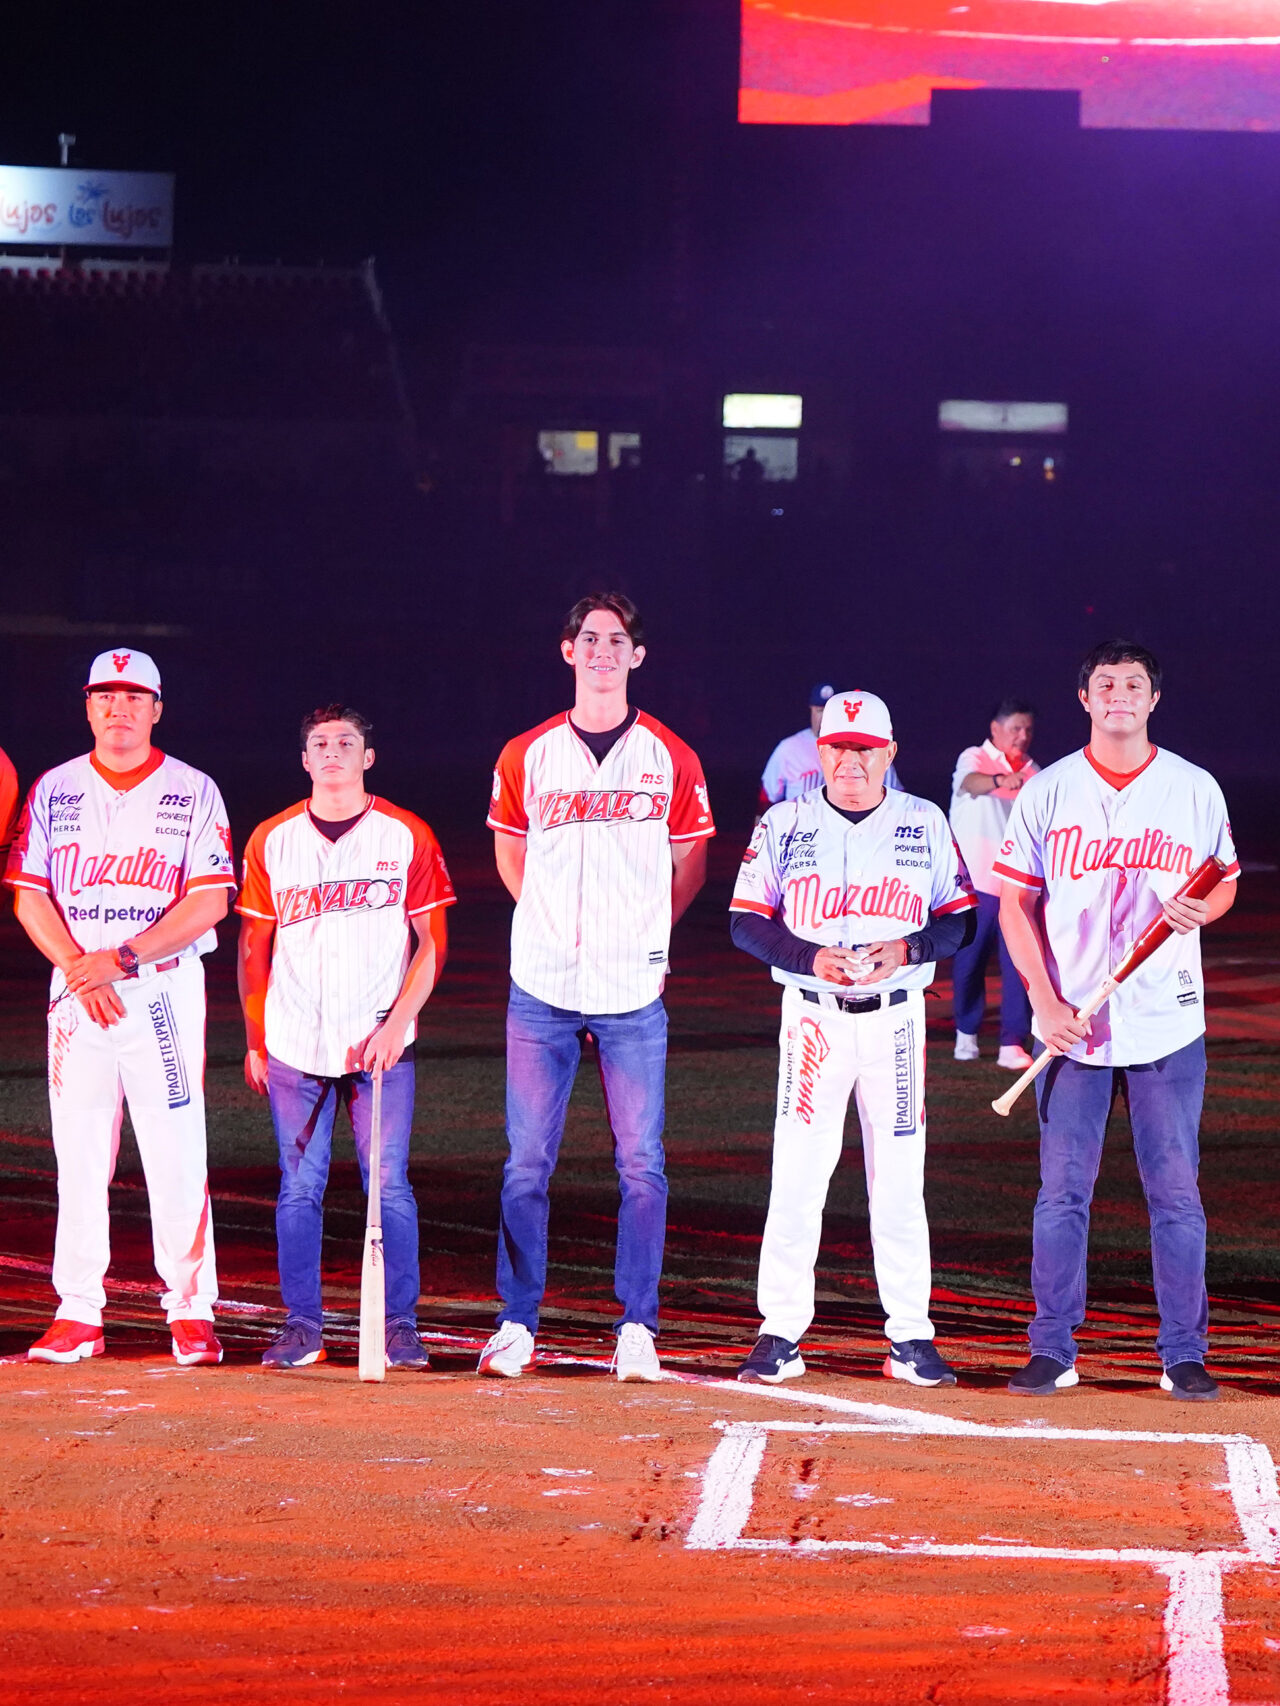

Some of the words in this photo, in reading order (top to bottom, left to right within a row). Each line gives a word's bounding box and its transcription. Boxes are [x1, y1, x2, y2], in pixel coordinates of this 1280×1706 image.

[159, 794, 193, 807] ms
[641, 774, 664, 785] ms
[538, 790, 669, 831] VENADOS
[894, 825, 925, 839] ms
[52, 842, 181, 898] Mazatlán
[376, 860, 399, 871] ms
[1046, 825, 1195, 881] Mazatlán
[69, 905, 99, 921] Red
[787, 873, 923, 929] Mazatlán
[148, 1000, 181, 1097] PAQUETEXPRESS
[796, 1016, 830, 1125] Caliente
[894, 1026, 909, 1124] PAQUETEXPRESS
